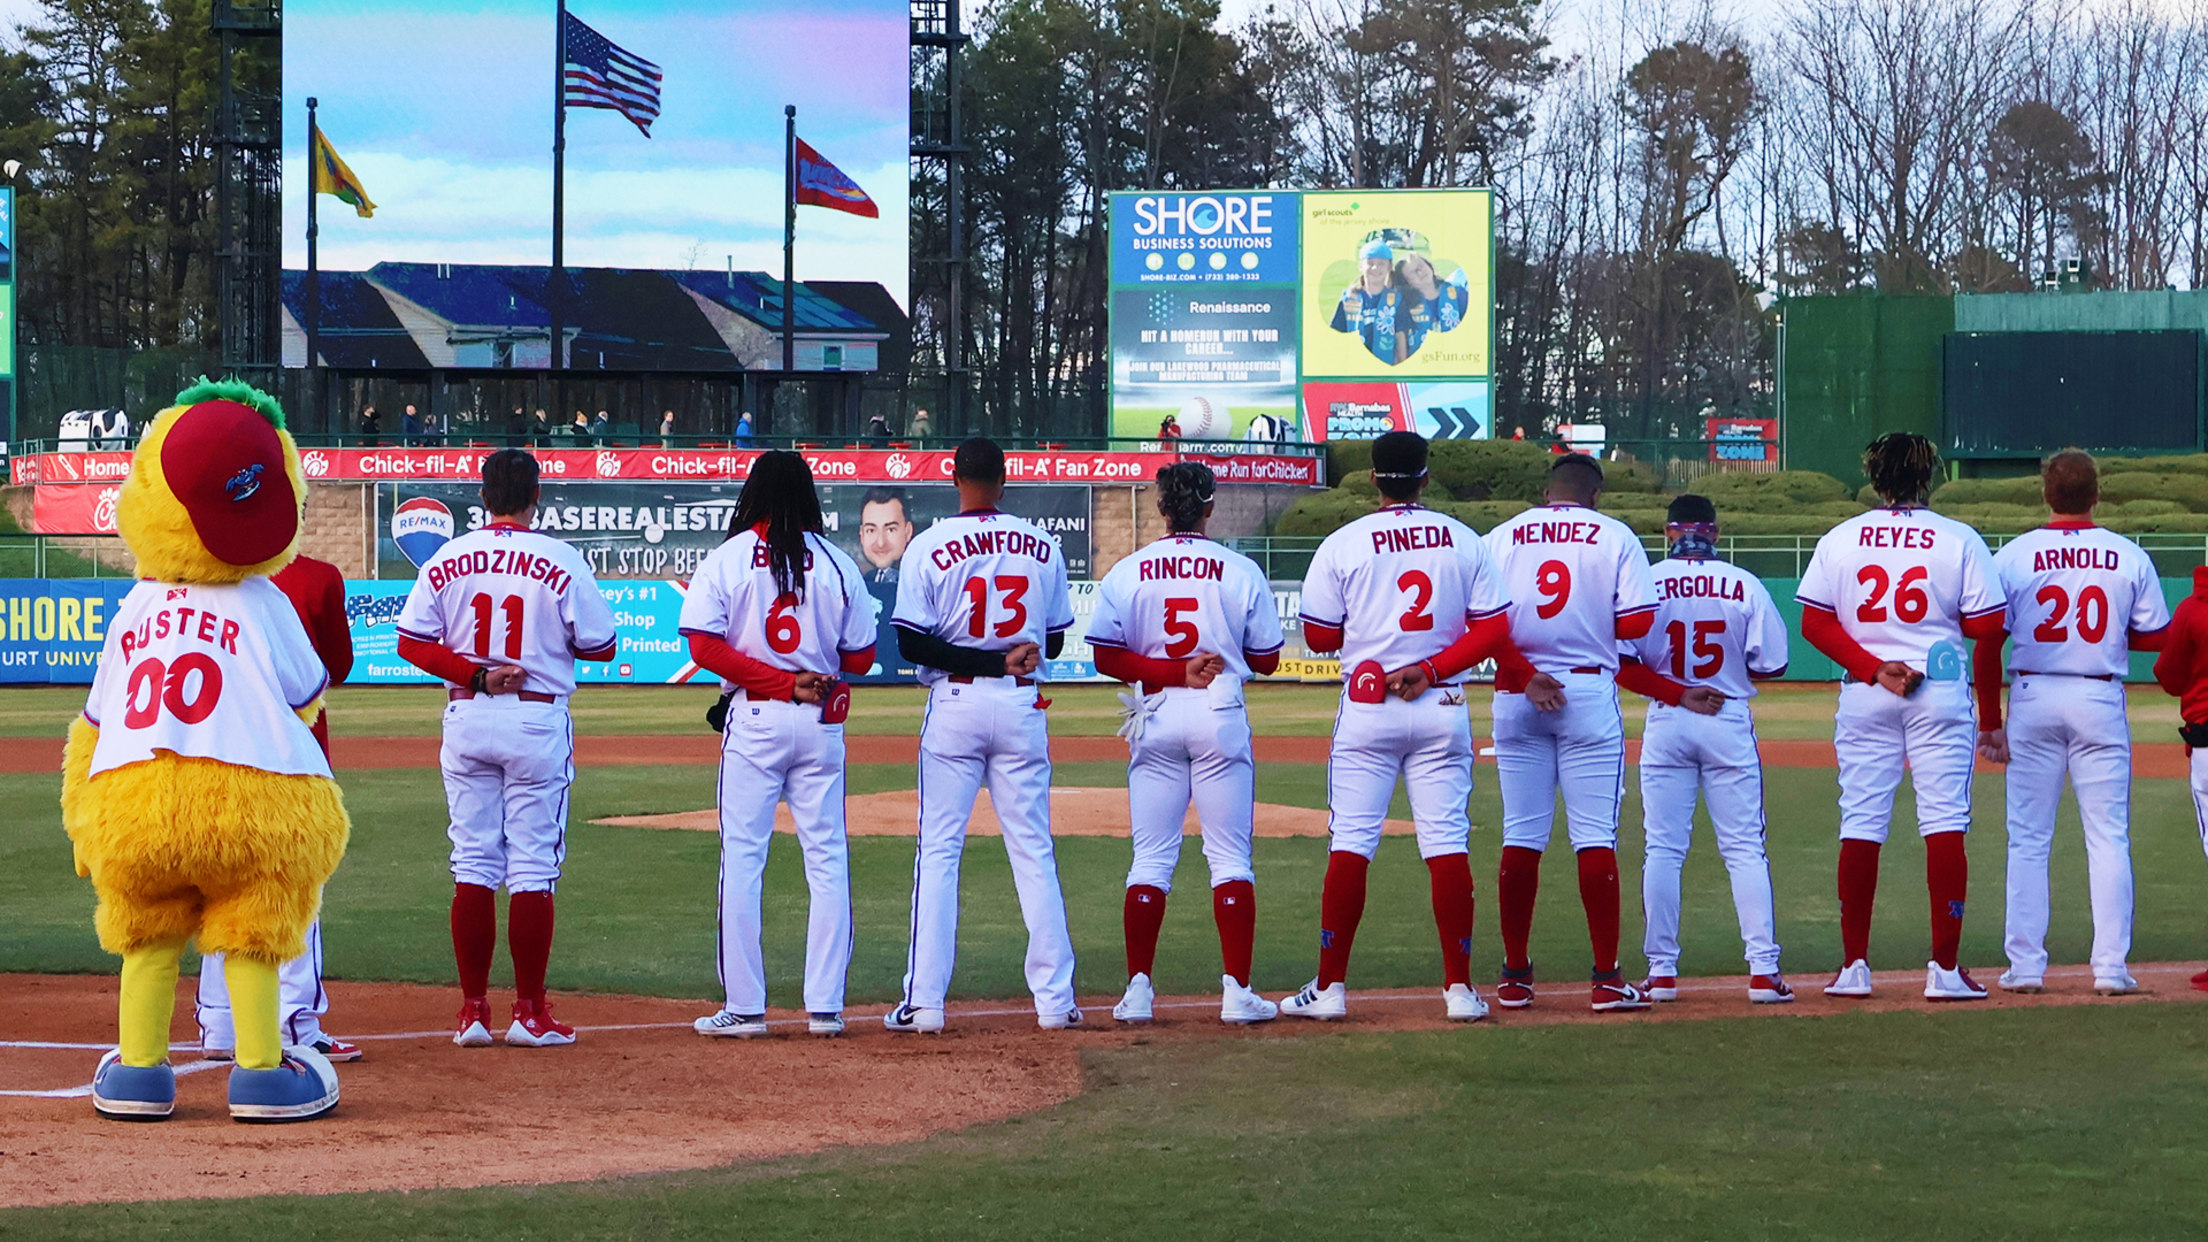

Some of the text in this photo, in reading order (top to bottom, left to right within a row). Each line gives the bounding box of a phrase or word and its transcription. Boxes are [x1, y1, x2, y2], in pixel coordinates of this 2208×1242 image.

[1133, 196, 1273, 236] SHORE
[1133, 236, 1273, 250] BUSINESS SOLUTIONS
[1189, 300, 1272, 314] Renaissance
[1140, 329, 1279, 343] HIT A HOMERUN WITH YOUR
[1150, 361, 1166, 373] OUR
[1421, 350, 1481, 364] gsFun.org
[1327, 417, 1395, 431] PROMO
[83, 458, 130, 477] Home
[540, 459, 566, 473] one
[1055, 458, 1089, 476] Fan
[1092, 459, 1142, 477] Zone
[1230, 460, 1250, 478] Run
[400, 516, 447, 529] RE/MAX
[1512, 521, 1601, 546] MENDEZ
[1371, 525, 1454, 554] PINEDA
[1859, 526, 1936, 549] REYES
[618, 547, 668, 576] STOP
[931, 530, 1051, 571] CRAWFORD
[2033, 547, 2119, 573] ARNOLD
[428, 549, 572, 596] BRODZINSKI
[1140, 556, 1224, 582] RINCON
[639, 587, 657, 601] #1
[1078, 583, 1094, 595] TO
[1396, 569, 1434, 632] 2
[1535, 559, 1572, 620] 9
[1655, 575, 1745, 603] ERGOLLA
[1856, 563, 1929, 624] 26
[963, 575, 1029, 638] 13
[2033, 584, 2109, 645] 20
[470, 591, 524, 660] 11
[614, 611, 656, 630] Shop
[765, 591, 801, 654] 6
[1163, 597, 1199, 659] 5
[622, 637, 682, 652] Printed
[1665, 619, 1727, 679] 15
[2, 650, 40, 667] URT
[367, 663, 431, 676] farroste
[1304, 664, 1341, 675] DRIV
[124, 651, 223, 730] 00
